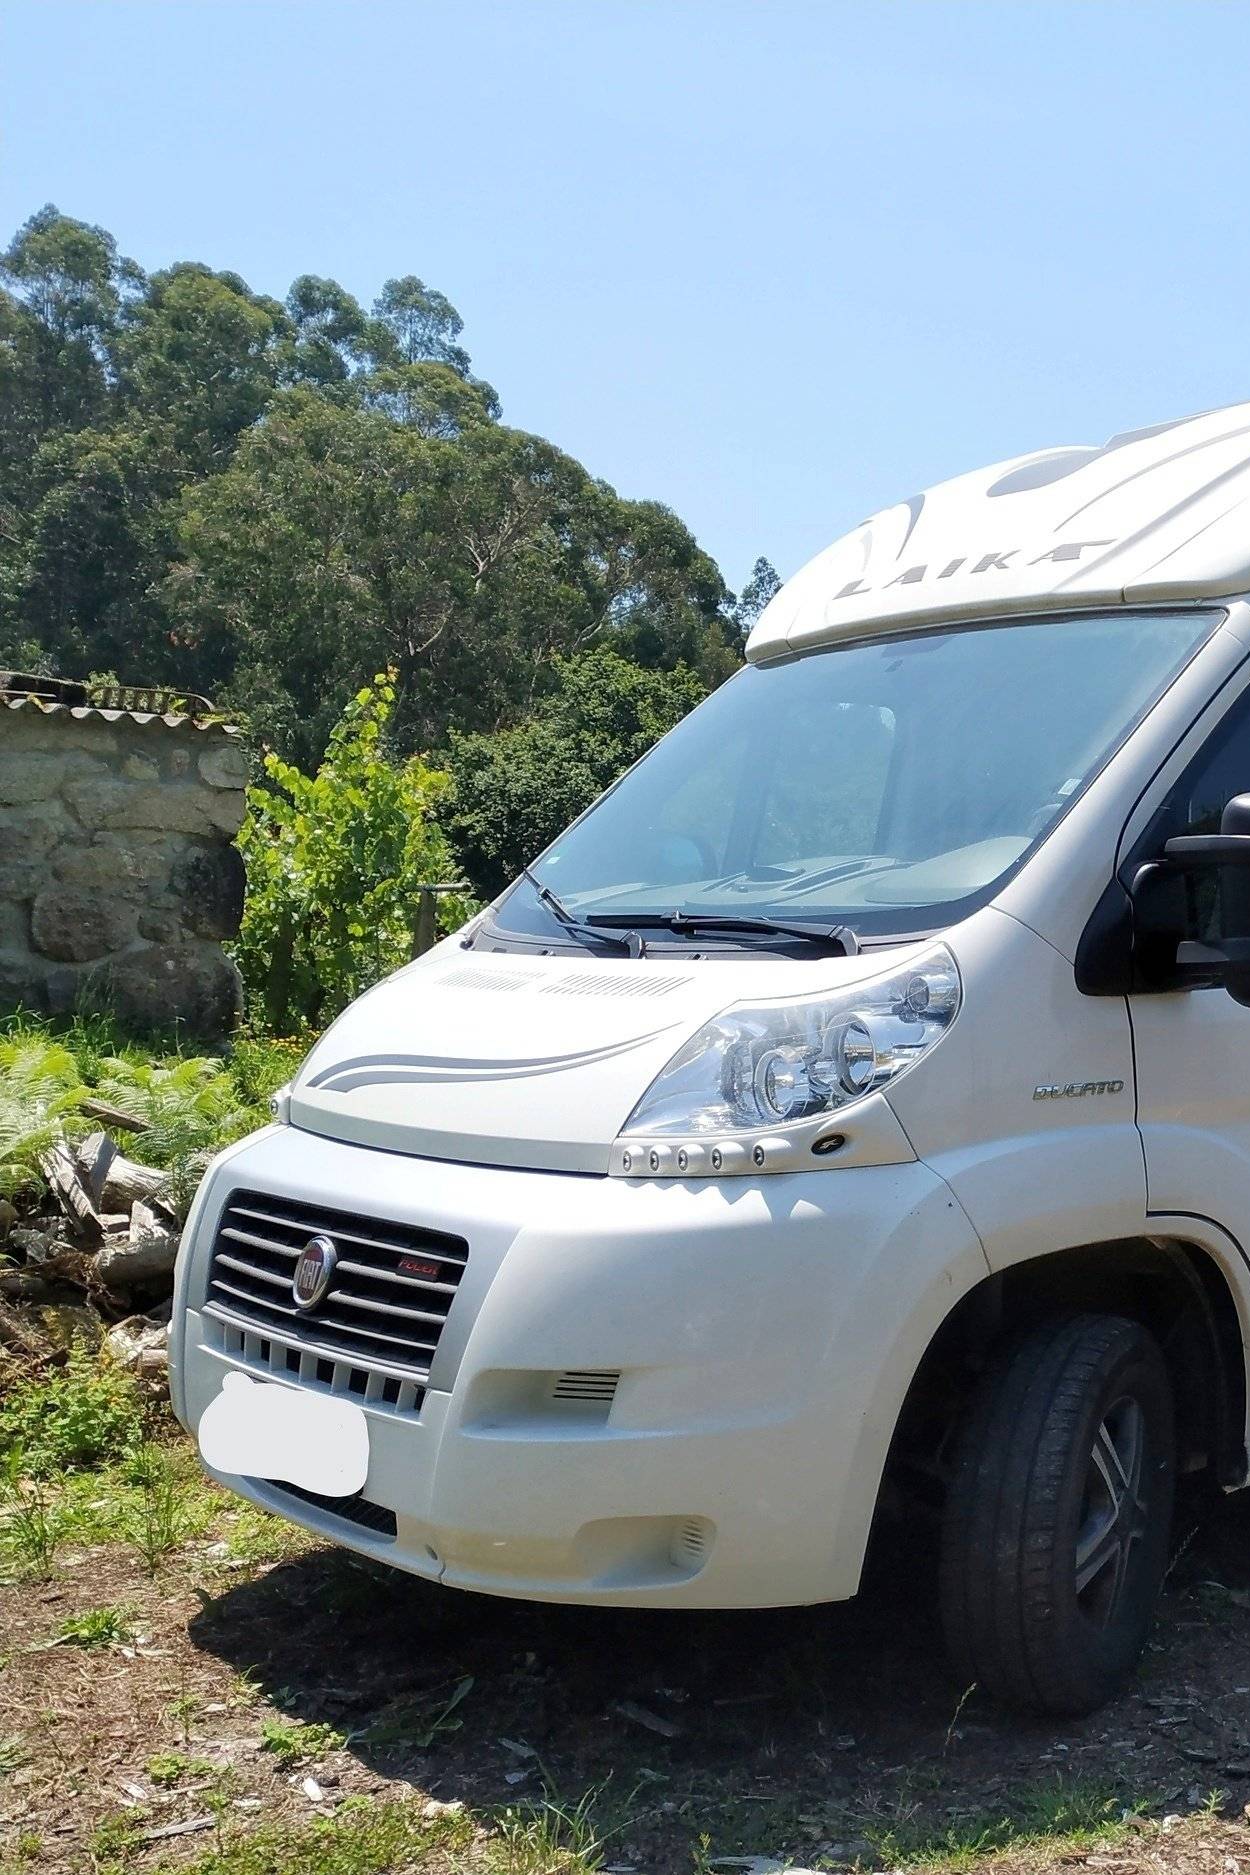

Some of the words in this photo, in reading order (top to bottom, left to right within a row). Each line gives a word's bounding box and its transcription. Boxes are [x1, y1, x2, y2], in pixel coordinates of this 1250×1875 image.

[832, 538, 1118, 601] LAIKA
[1032, 1080, 1124, 1101] DUCATO
[299, 1258, 322, 1291] FIAT
